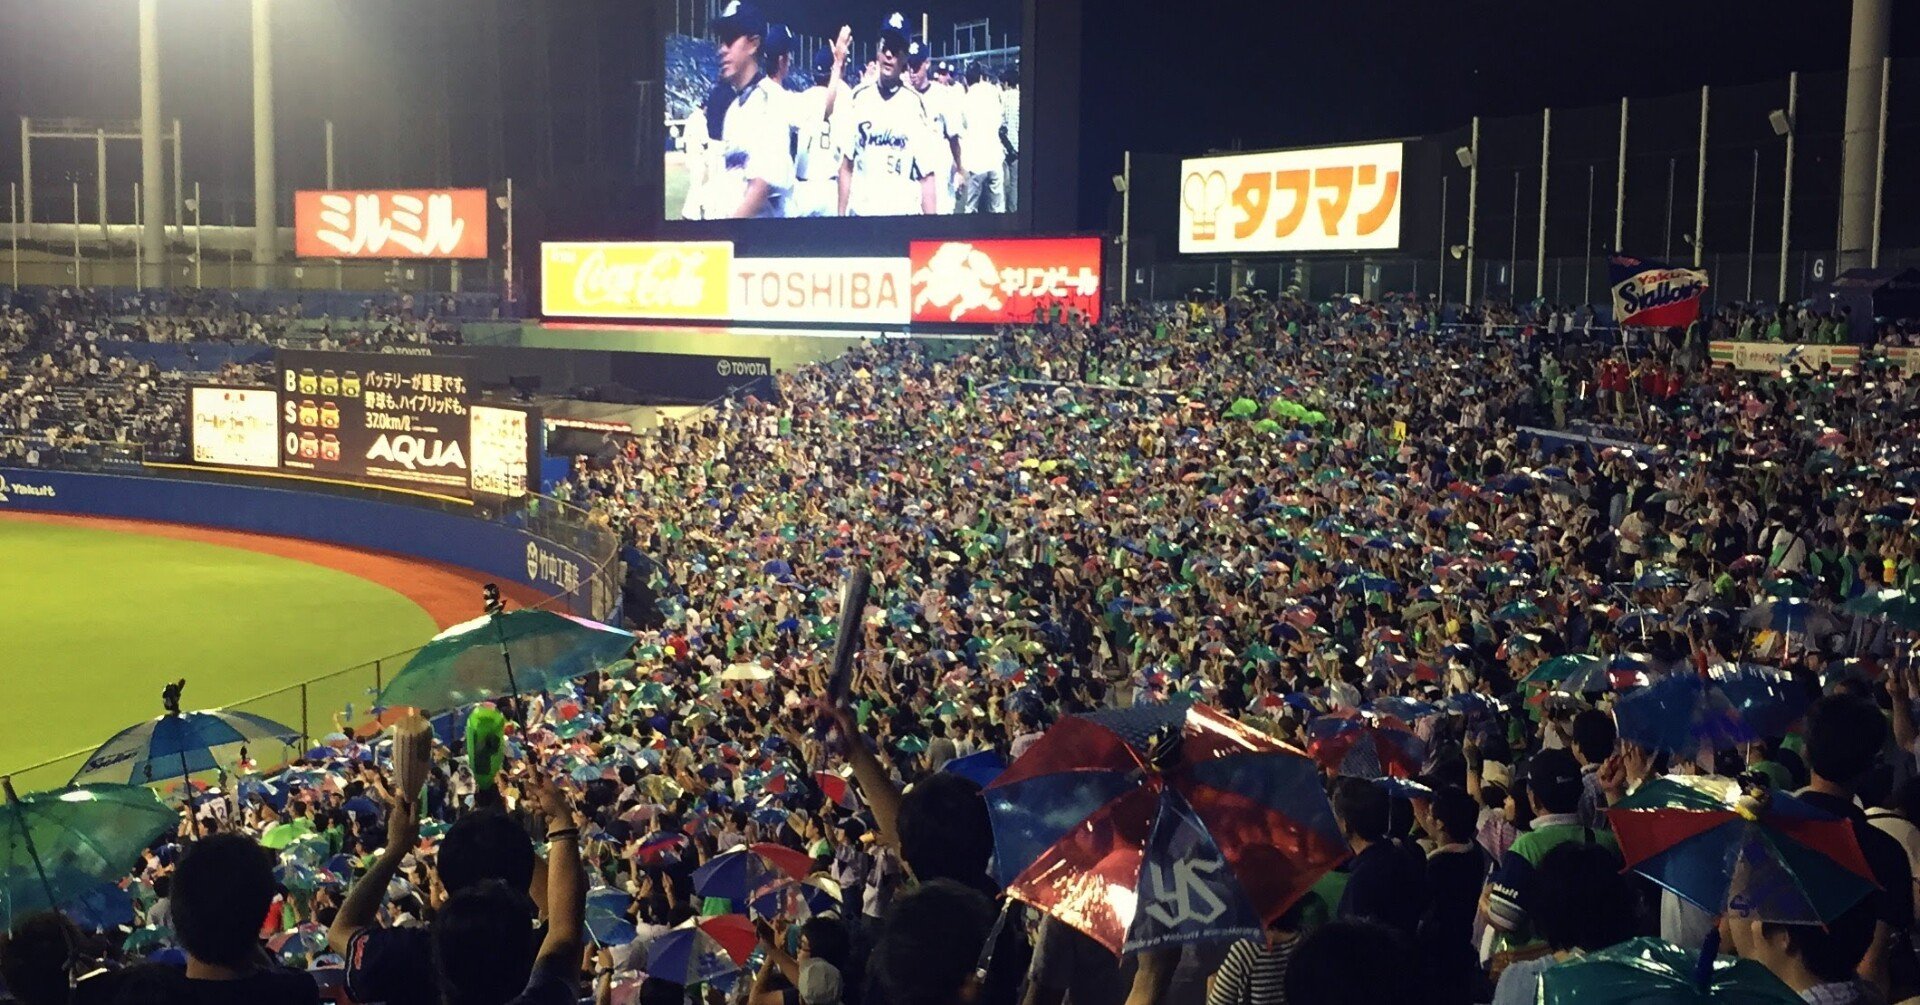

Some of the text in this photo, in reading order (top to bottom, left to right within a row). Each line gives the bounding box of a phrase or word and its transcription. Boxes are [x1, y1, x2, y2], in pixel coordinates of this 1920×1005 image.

[1232, 164, 1400, 239] タフマン
[316, 194, 465, 256] ミルミル
[1135, 269, 1144, 285] L
[1246, 269, 1256, 287] K
[1371, 267, 1380, 283] J
[1814, 259, 1824, 278] G
[738, 271, 898, 309] TOSHIBA
[999, 265, 1099, 297] キリンビール
[732, 361, 768, 375] TOYOTA
[285, 369, 297, 392] B
[285, 400, 297, 424] S
[366, 433, 467, 469] AQUA
[11, 483, 56, 497] Yakult
